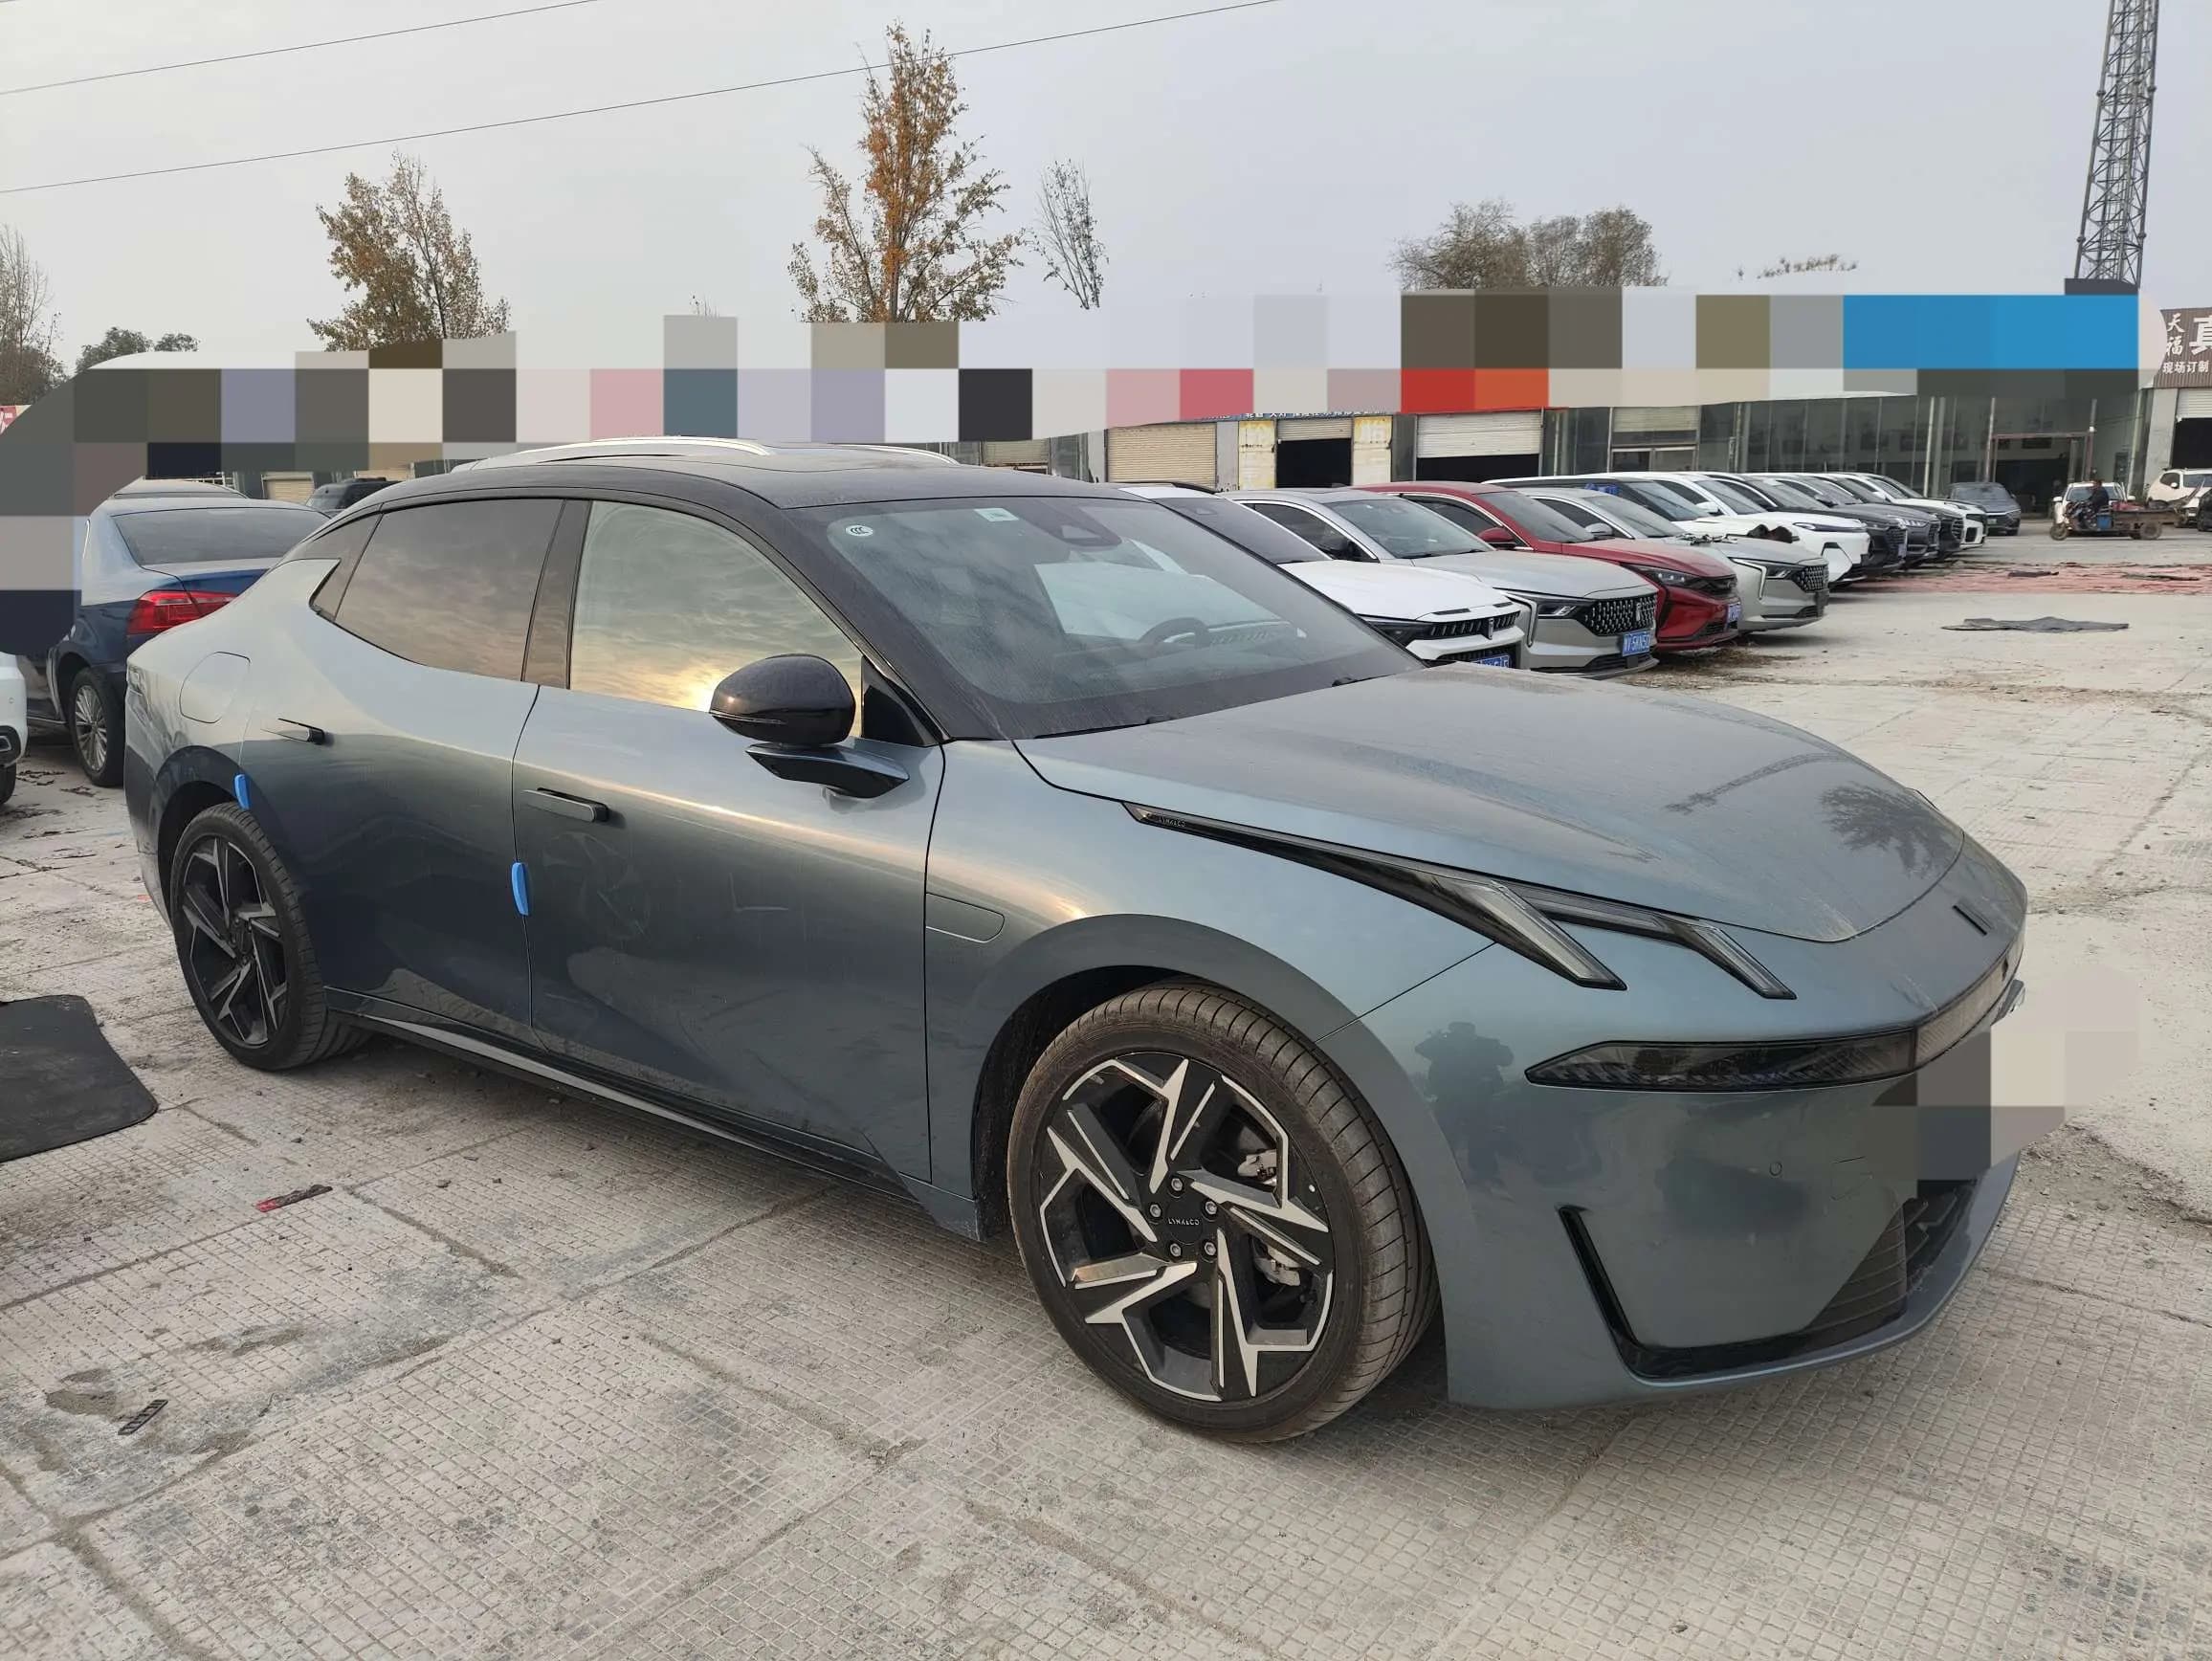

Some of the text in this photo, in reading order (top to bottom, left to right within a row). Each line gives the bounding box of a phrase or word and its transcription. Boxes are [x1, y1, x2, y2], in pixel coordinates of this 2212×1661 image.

[2166, 312, 2185, 356] 天福
[2162, 360, 2210, 374] 现场订制
